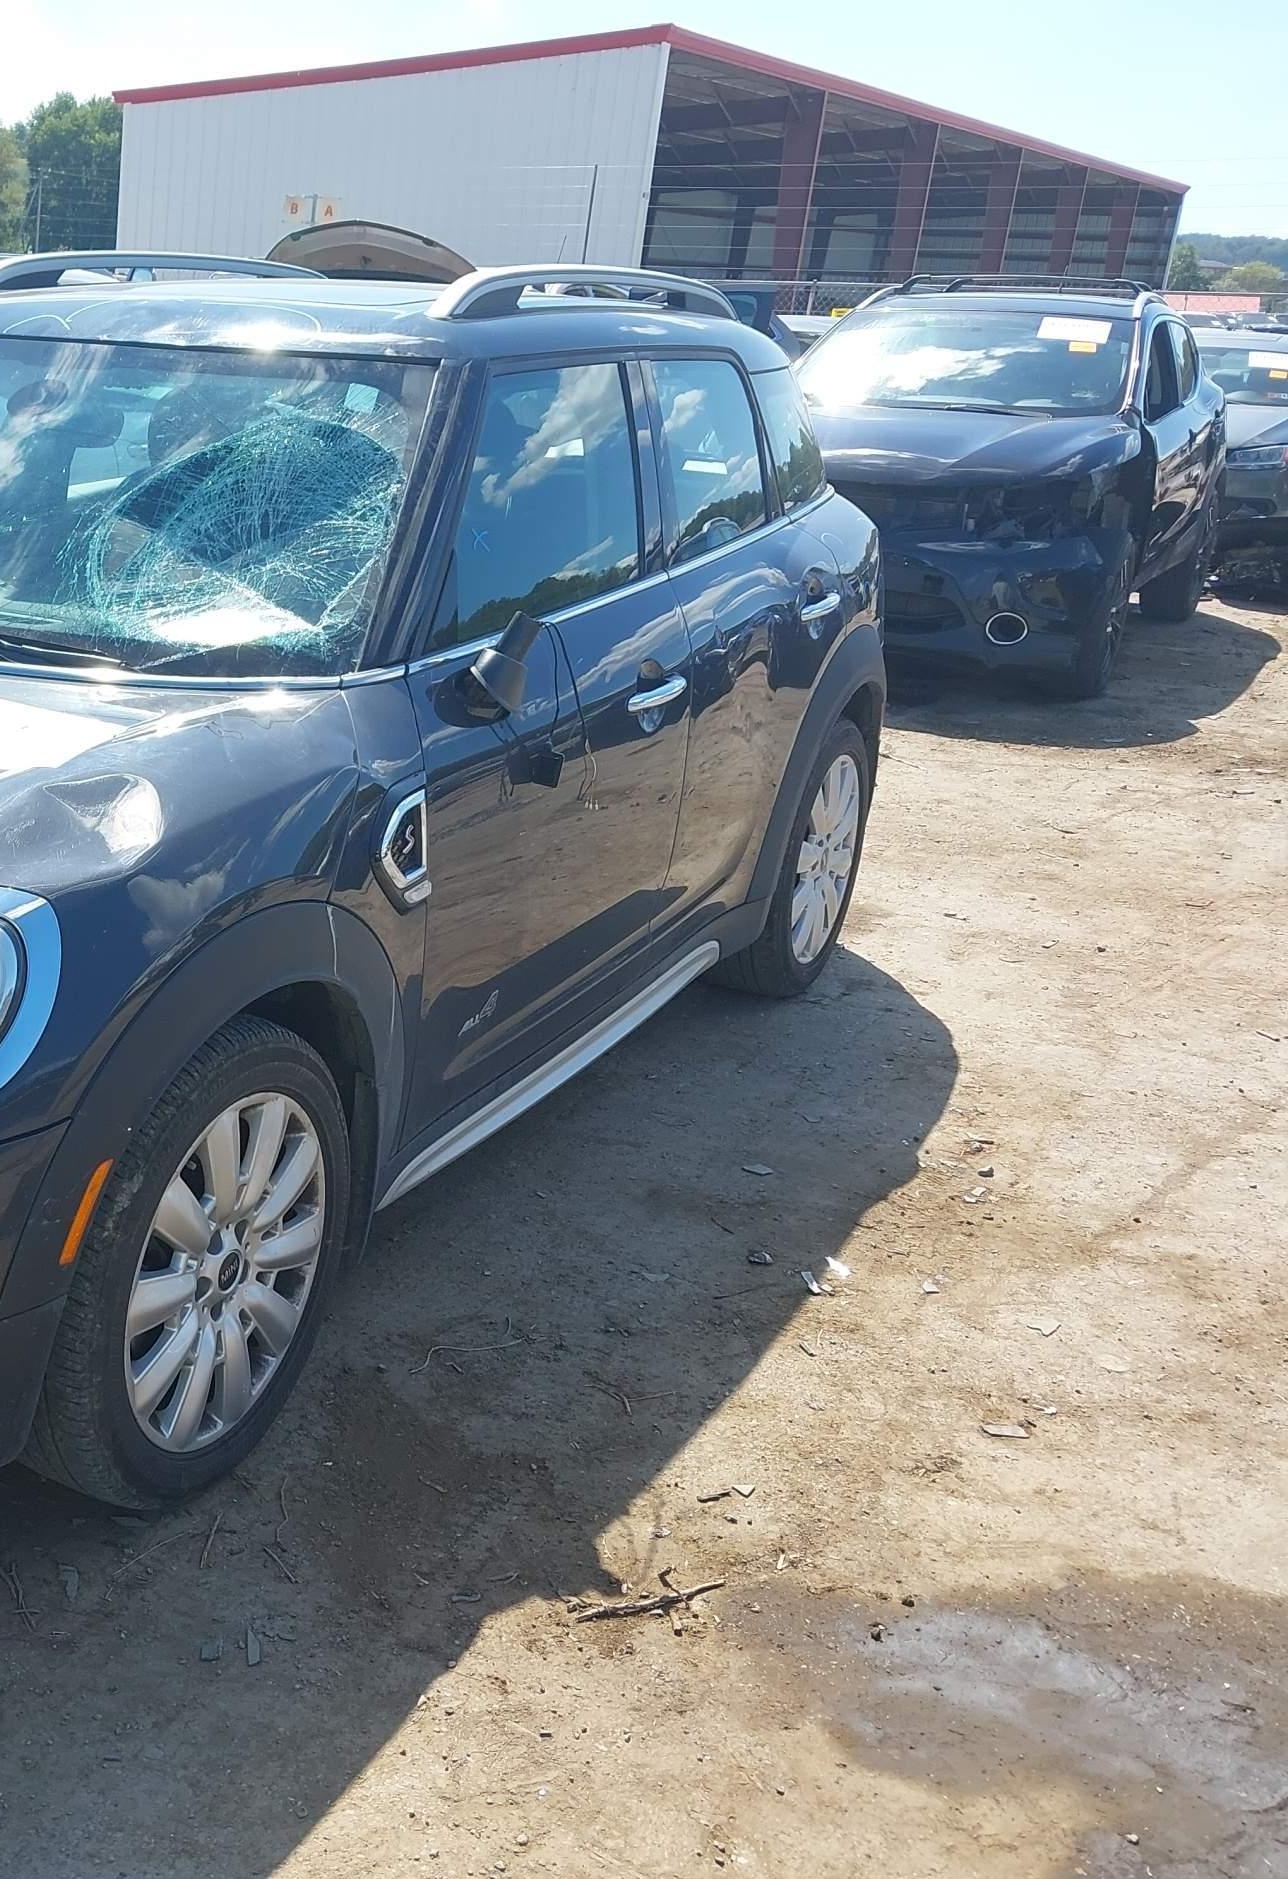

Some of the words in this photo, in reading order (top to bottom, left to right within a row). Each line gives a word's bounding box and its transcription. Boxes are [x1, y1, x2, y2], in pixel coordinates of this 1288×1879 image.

[290, 202, 298, 214] B
[324, 205, 333, 217] A
[220, 1259, 239, 1283] MINI
